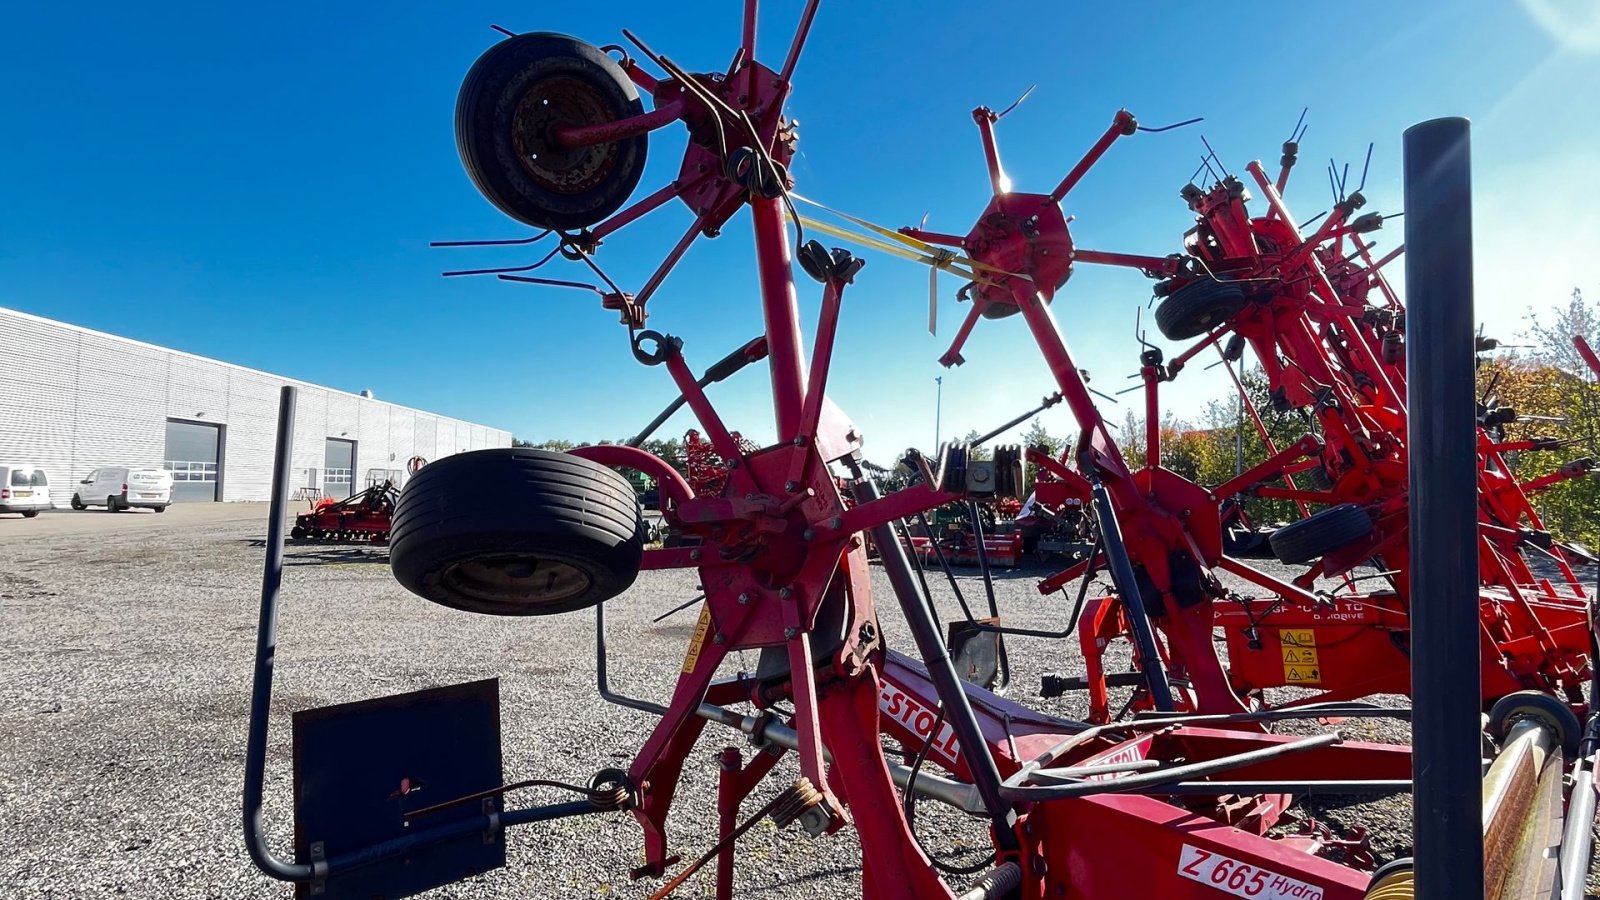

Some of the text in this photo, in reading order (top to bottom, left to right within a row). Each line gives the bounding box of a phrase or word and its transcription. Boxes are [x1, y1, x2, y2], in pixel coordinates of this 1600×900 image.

[1182, 849, 1322, 900] Z 665 Hydro
